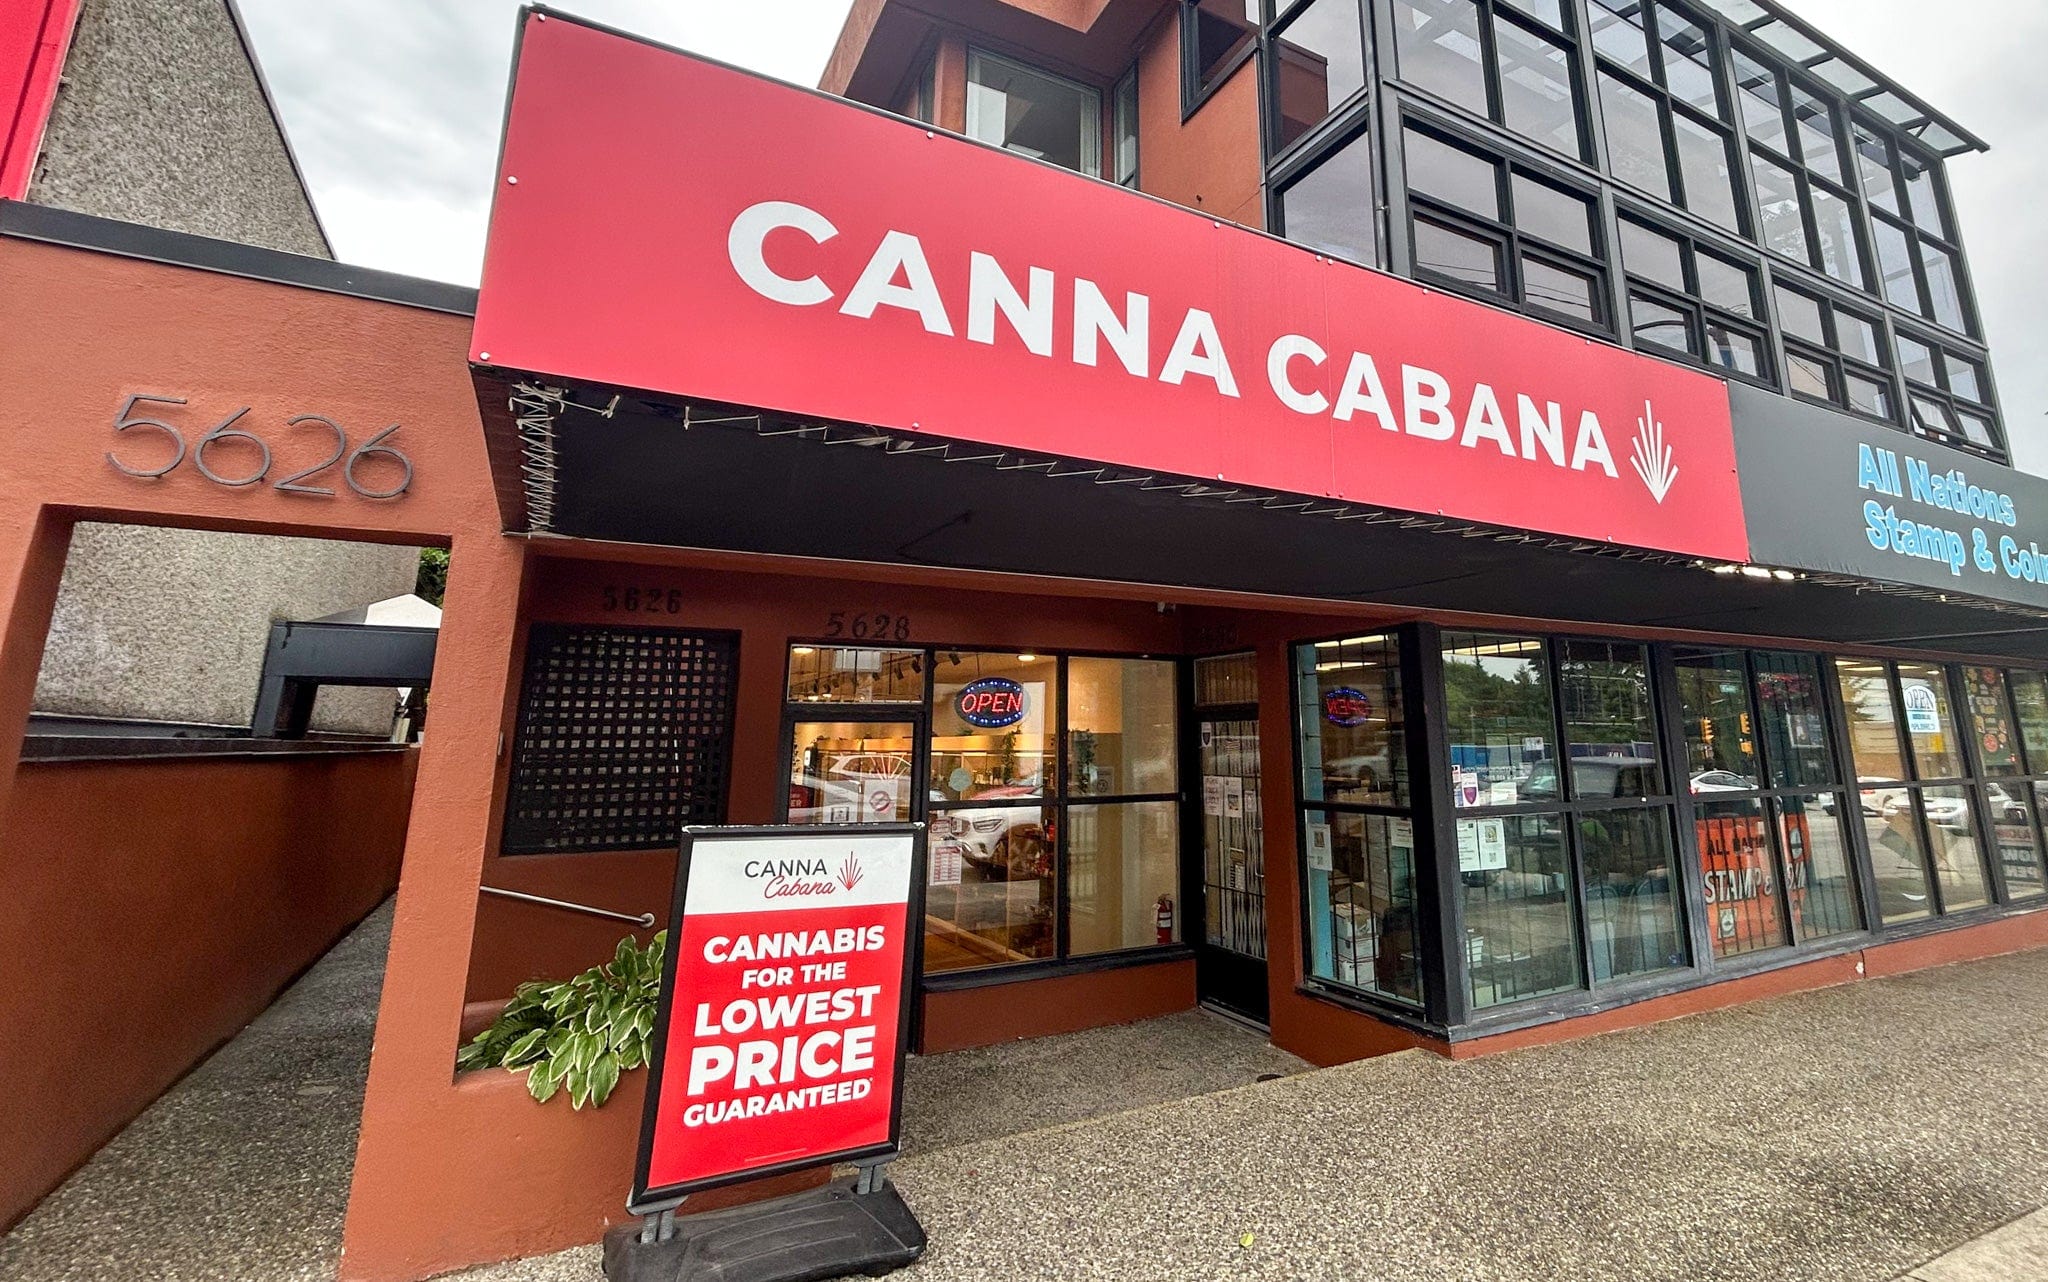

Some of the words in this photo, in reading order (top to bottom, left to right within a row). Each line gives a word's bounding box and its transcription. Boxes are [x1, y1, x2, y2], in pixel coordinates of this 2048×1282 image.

[727, 200, 1241, 398] CANNA
[1266, 334, 1620, 478] CABANA
[106, 393, 413, 499] 5626
[1858, 442, 1903, 497] All
[1904, 455, 2017, 527] Nations
[1863, 499, 1966, 576] Stamp
[1971, 527, 1997, 575] &
[601, 585, 682, 614] 5626
[823, 610, 911, 642] 5628
[961, 692, 1023, 713] OPEN
[1906, 688, 1934, 710] OPEN
[745, 858, 827, 879] CANNA
[764, 874, 836, 899] Cabana
[1704, 867, 1761, 904] STAMP
[703, 925, 886, 964] CANNABIS
[742, 966, 794, 989] FOR
[801, 962, 847, 984] THE
[694, 985, 881, 1038] LOWEST
[686, 1025, 876, 1096] PRICE
